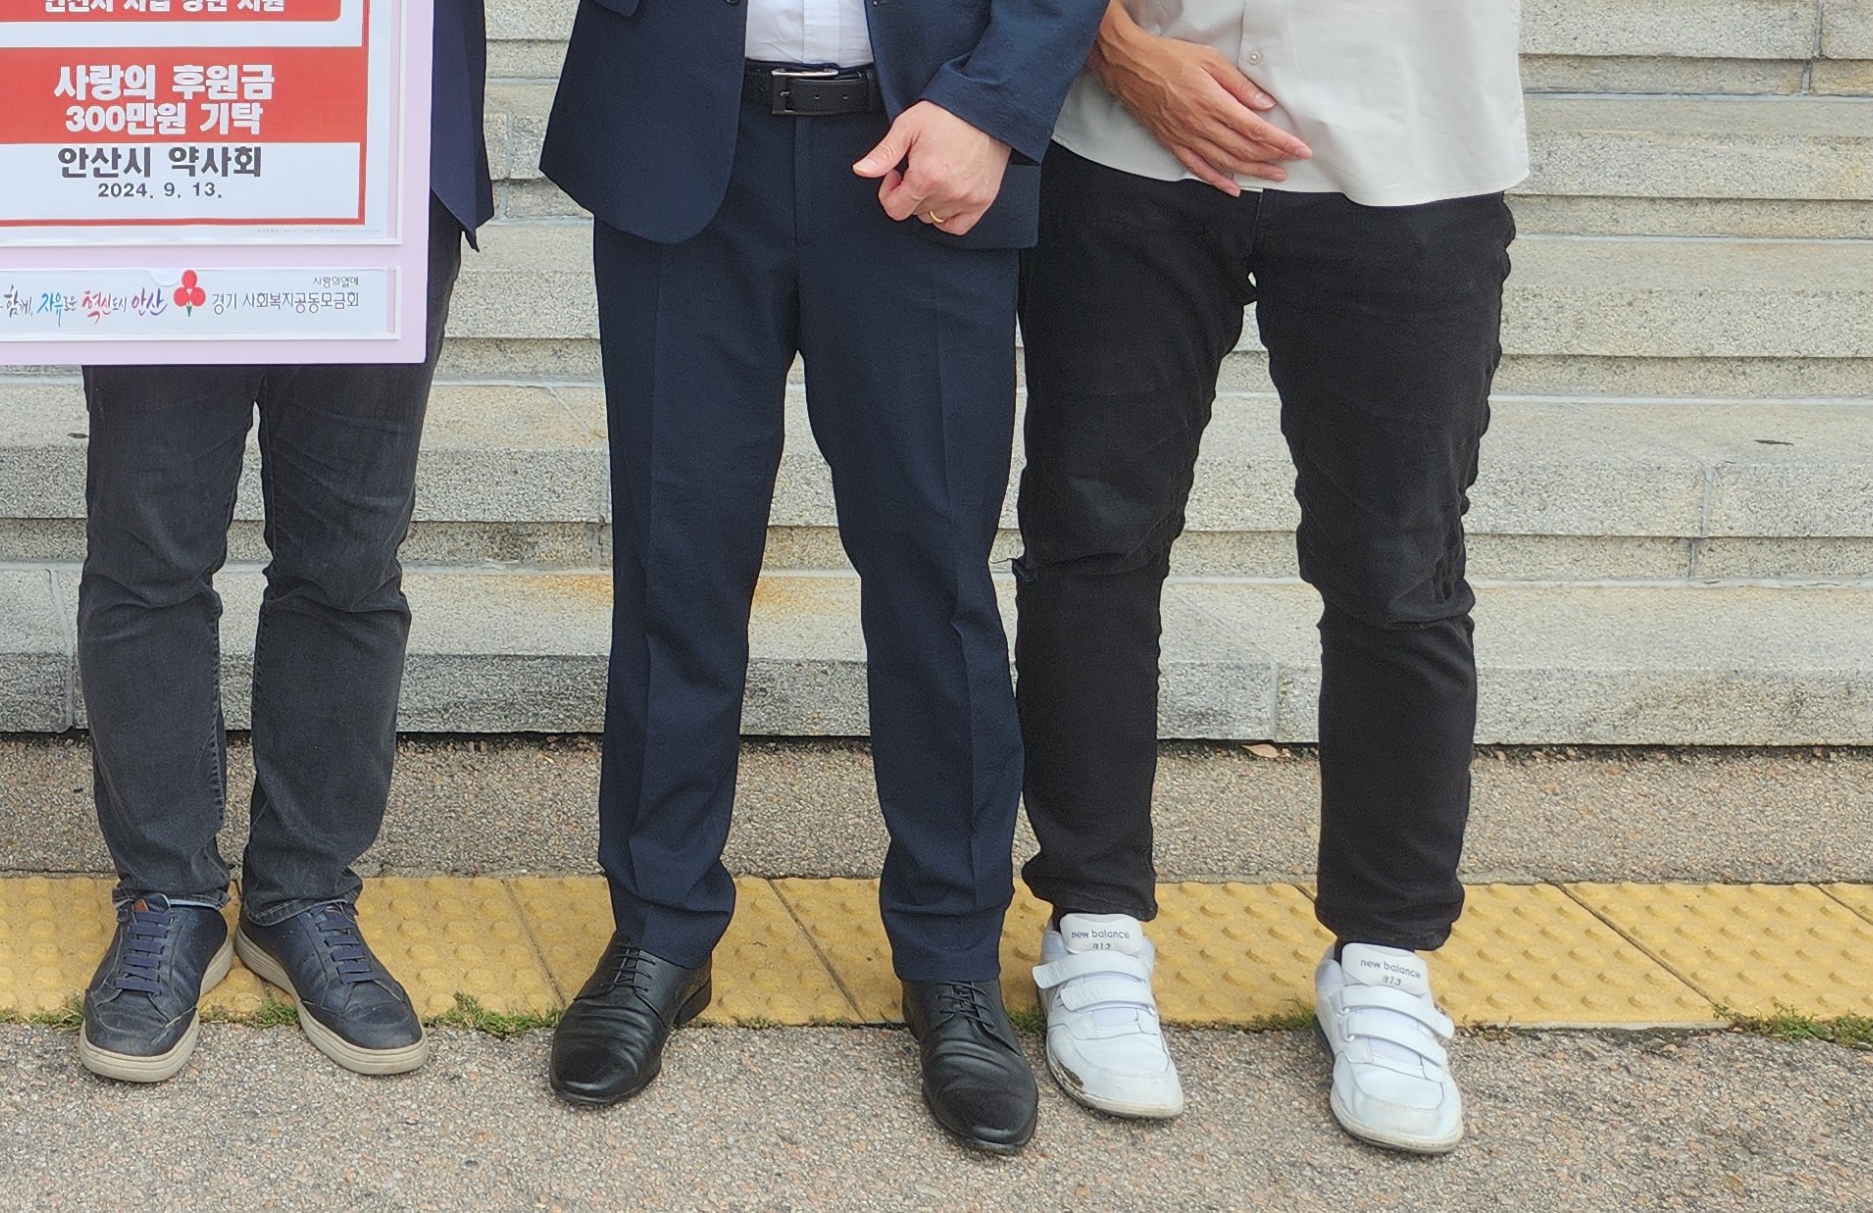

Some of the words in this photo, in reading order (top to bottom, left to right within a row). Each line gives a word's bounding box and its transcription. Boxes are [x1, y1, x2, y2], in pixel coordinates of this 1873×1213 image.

[53, 63, 156, 101] 사랑의
[171, 63, 276, 101] 후원금
[65, 102, 187, 136] 300만원
[200, 102, 264, 136] 기탁
[57, 146, 152, 179] 안산시
[168, 146, 263, 178] 약사회
[97, 182, 155, 200] 2024.
[163, 182, 182, 199] 9.
[192, 182, 224, 199] 13.
[36, 291, 78, 328] 자유로운
[81, 290, 128, 325] 혁신도시
[131, 287, 168, 317] 안산
[212, 292, 237, 315] 경기
[242, 291, 359, 314] 사회복지공동모금회
[1071, 931, 1089, 939] new
[1091, 929, 1130, 939] balance
[1360, 959, 1381, 969] new
[1383, 961, 1421, 979] balance
[1382, 975, 1402, 986] 813
